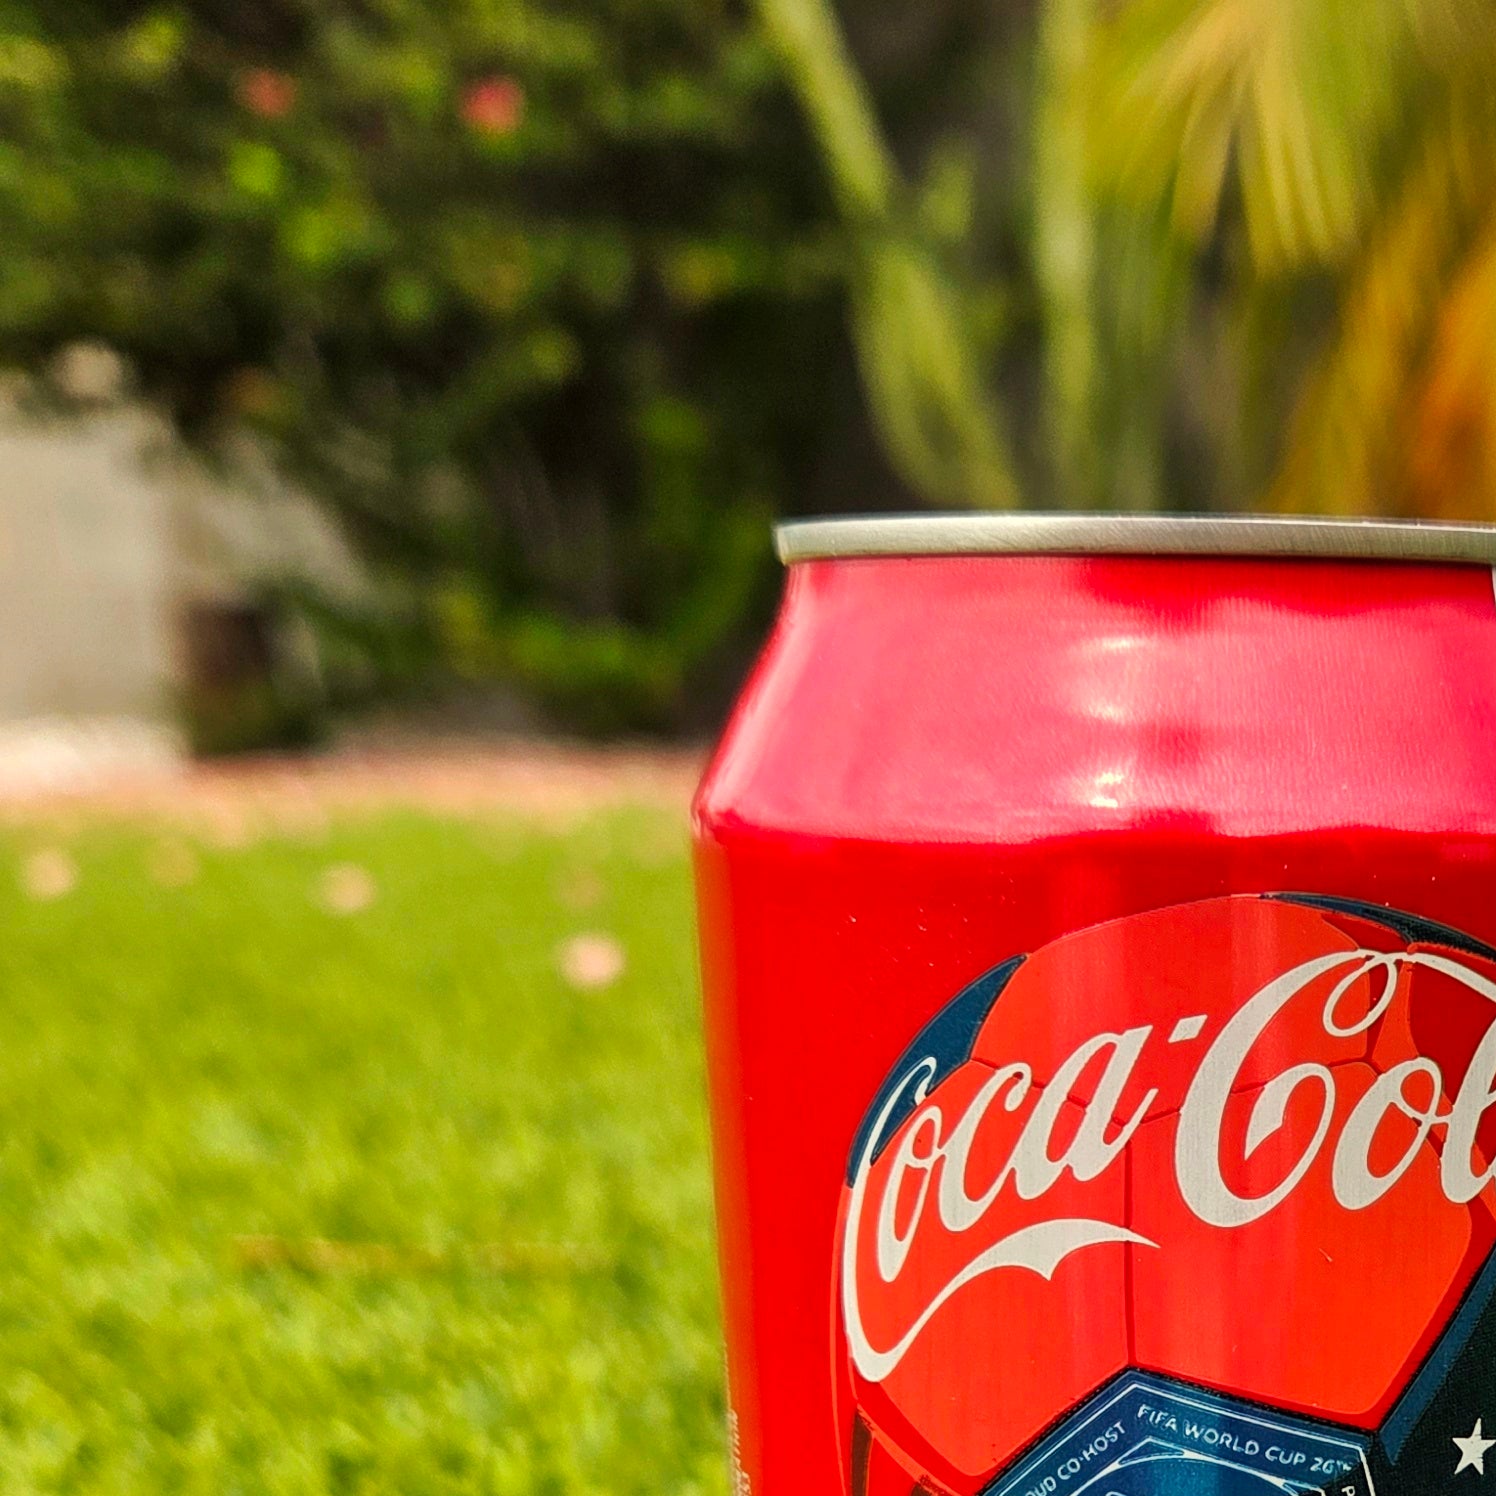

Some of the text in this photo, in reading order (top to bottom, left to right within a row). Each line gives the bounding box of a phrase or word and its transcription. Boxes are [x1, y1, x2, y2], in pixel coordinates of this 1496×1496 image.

[1137, 1403, 1178, 1433] FIFA
[1182, 1419, 1260, 1456] WORLD
[1264, 1445, 1307, 1466] CUP
